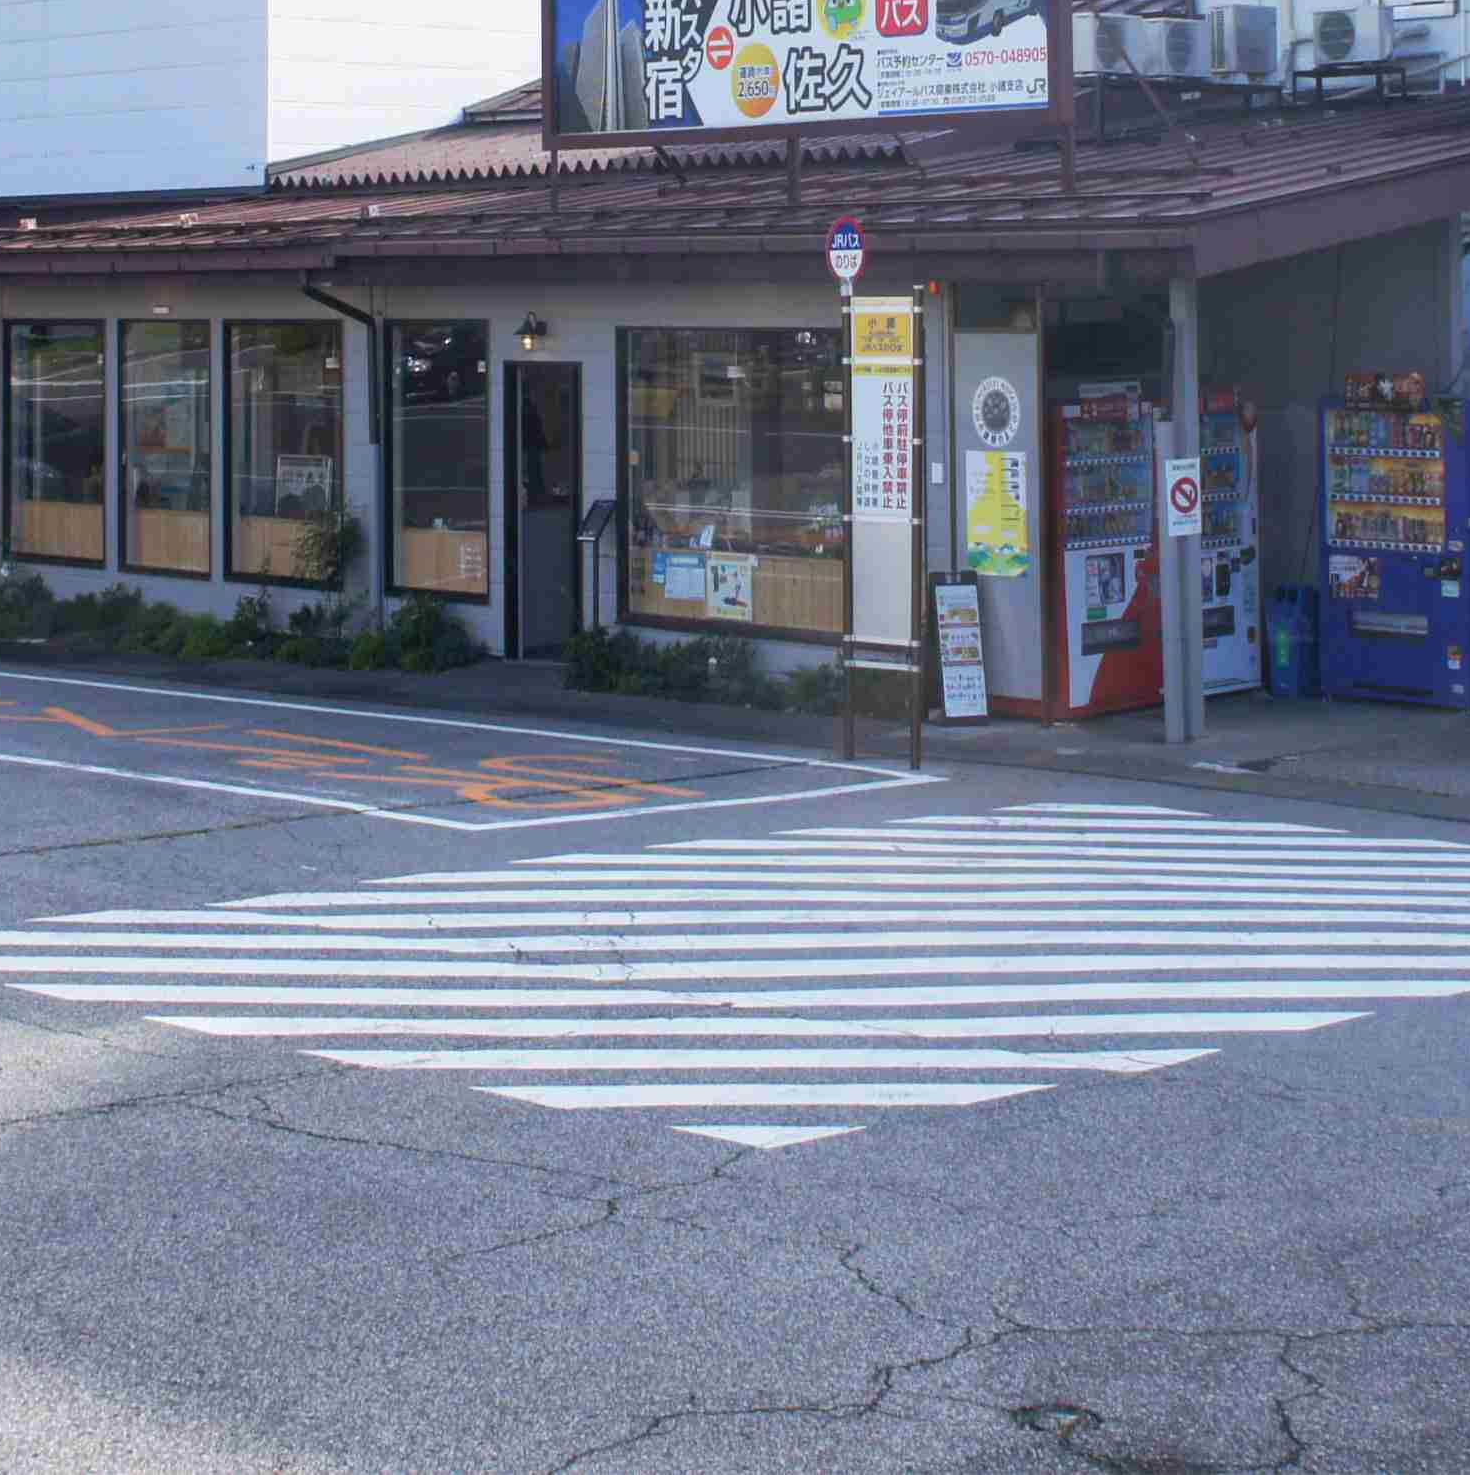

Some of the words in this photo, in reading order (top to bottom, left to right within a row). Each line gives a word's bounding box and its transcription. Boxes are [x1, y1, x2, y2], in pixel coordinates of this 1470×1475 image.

[782, 43, 872, 114] 佐久
[1026, 78, 1046, 94] JR
[832, 233, 860, 248] JRバス
[835, 254, 858, 269] のりば
